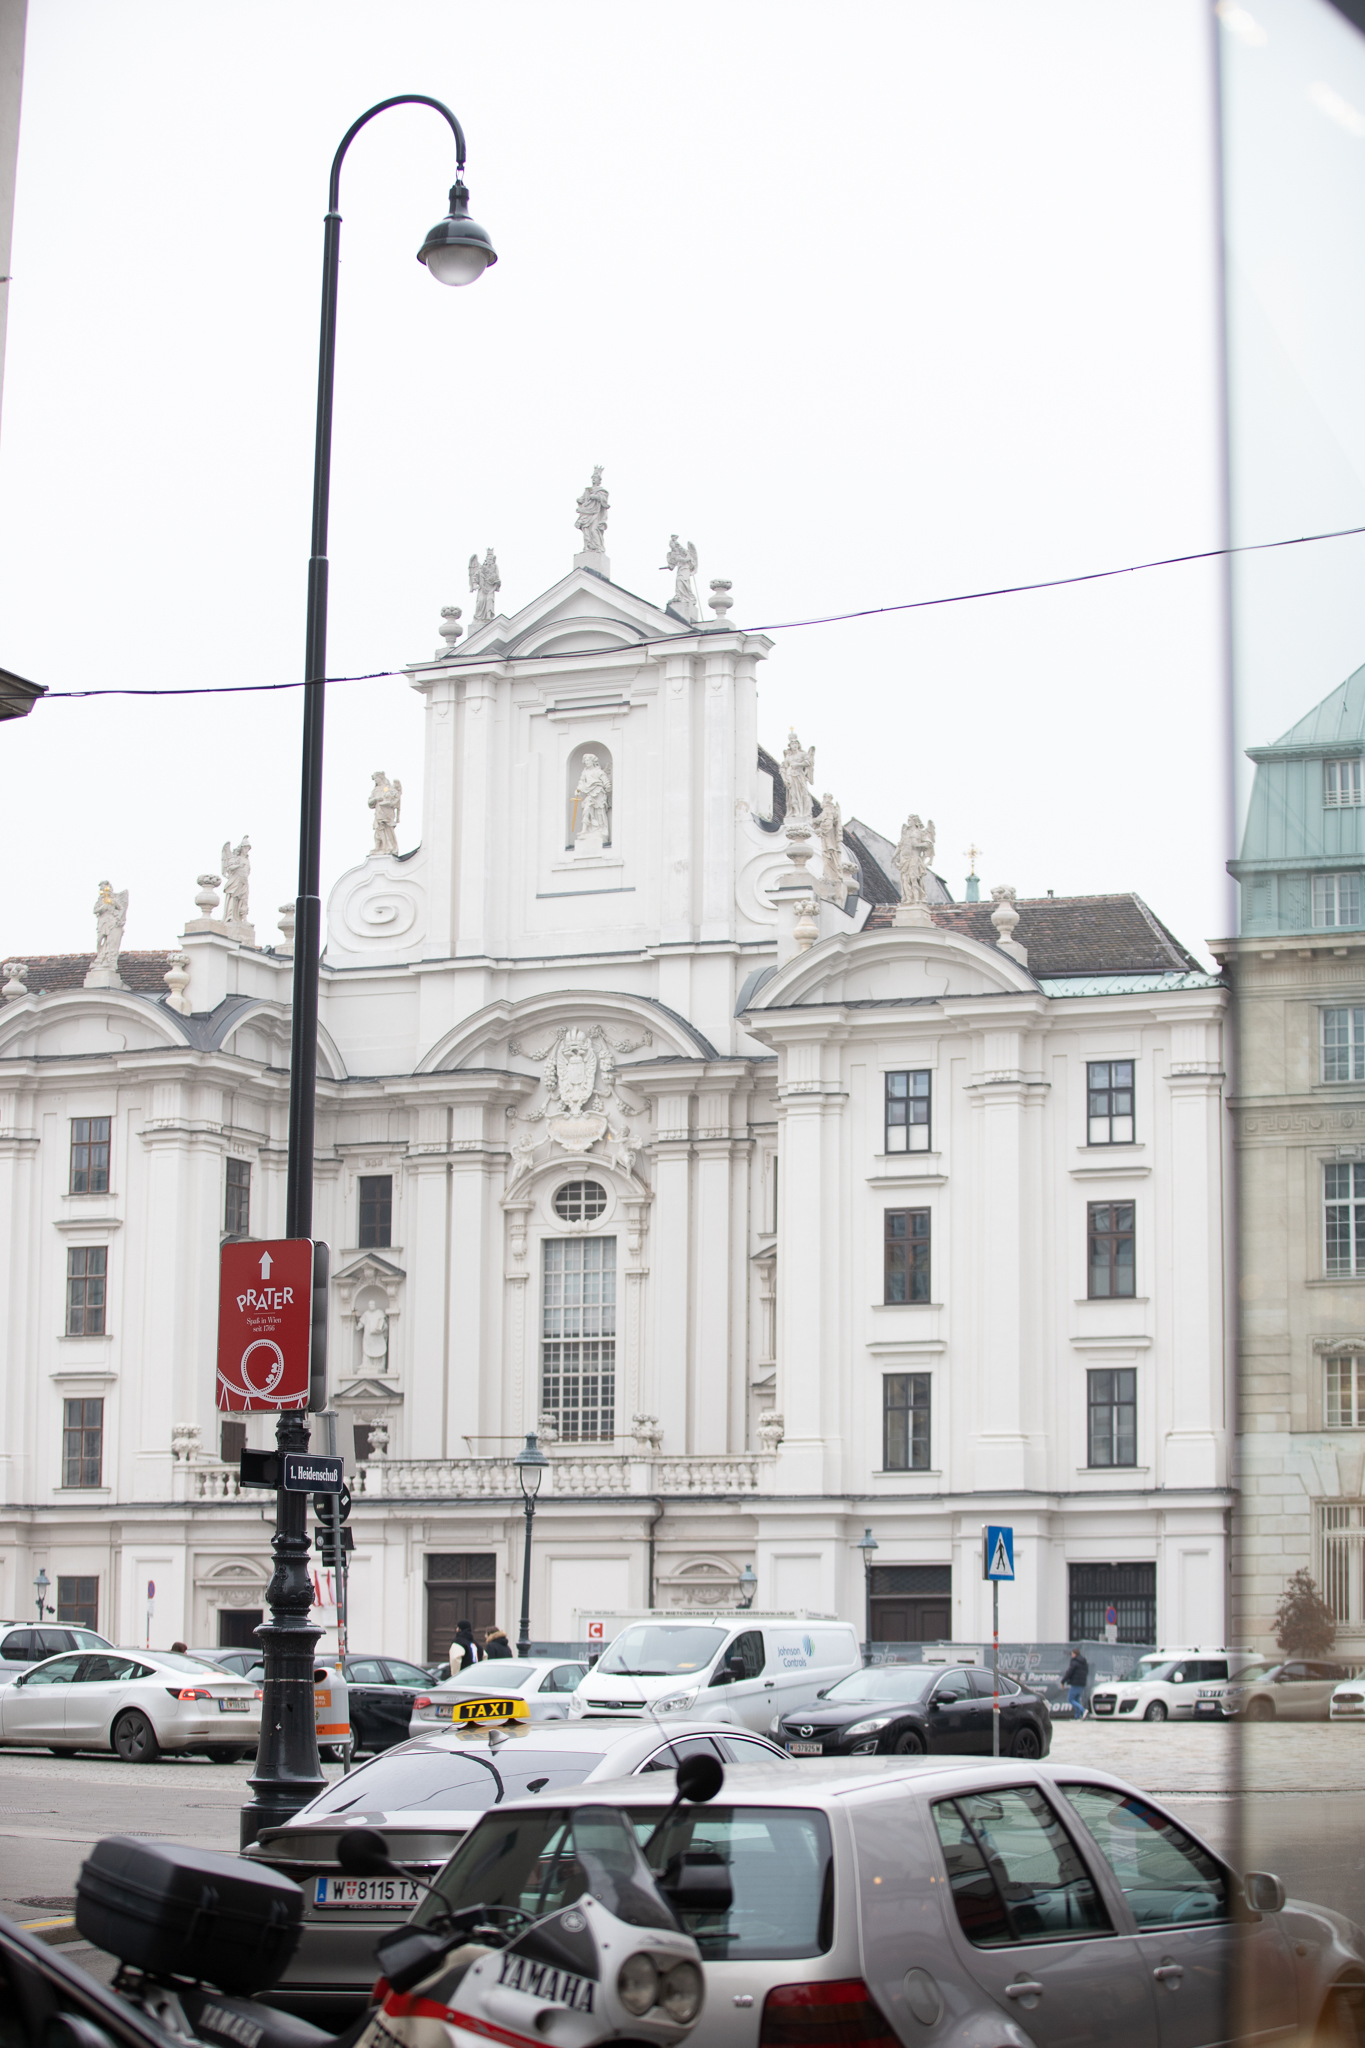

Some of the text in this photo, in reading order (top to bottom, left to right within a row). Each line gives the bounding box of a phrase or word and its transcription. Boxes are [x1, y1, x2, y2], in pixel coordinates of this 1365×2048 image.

[236, 1286, 294, 1312] PRATER
[263, 1324, 276, 1332] 1766
[267, 1316, 282, 1324] Wien
[297, 1465, 338, 1482] Heidenschuß
[777, 1645, 801, 1657] Johnson
[783, 1656, 807, 1668] Controls
[1028, 1673, 1060, 1681] Partner
[466, 1702, 507, 1718] TAXI
[333, 1881, 420, 1899] W 8115 TX
[498, 1951, 595, 2014] YAMAHA
[199, 2003, 264, 2048] YAMAHA
